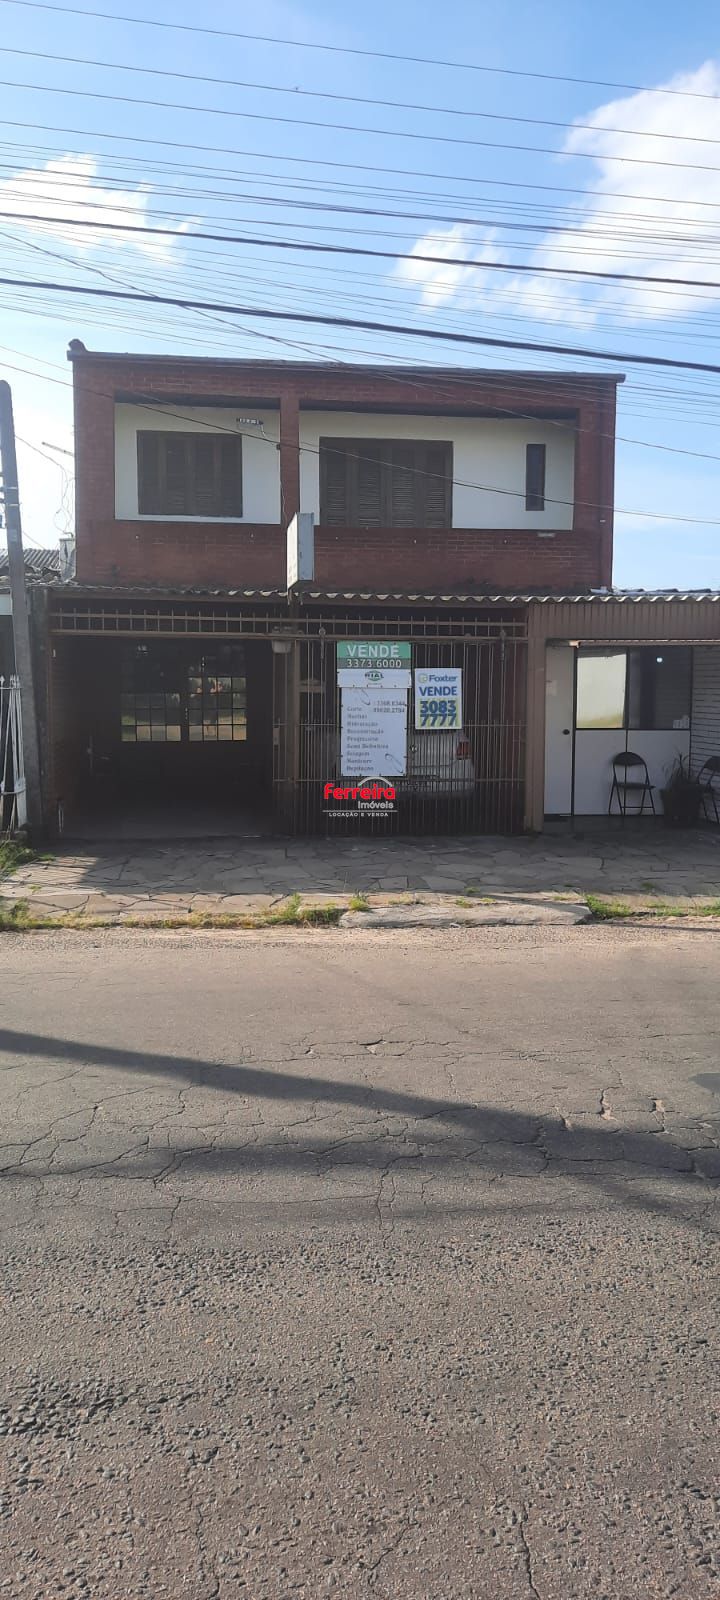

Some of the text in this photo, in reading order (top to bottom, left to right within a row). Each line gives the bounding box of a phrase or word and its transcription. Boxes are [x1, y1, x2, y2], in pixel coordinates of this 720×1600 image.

[347, 645, 400, 657] VENDE
[347, 659, 402, 668] 3373 6000
[428, 674, 457, 682] Foxter
[418, 686, 458, 697] VENDE
[420, 700, 457, 714] 3083
[420, 714, 457, 727] 7777
